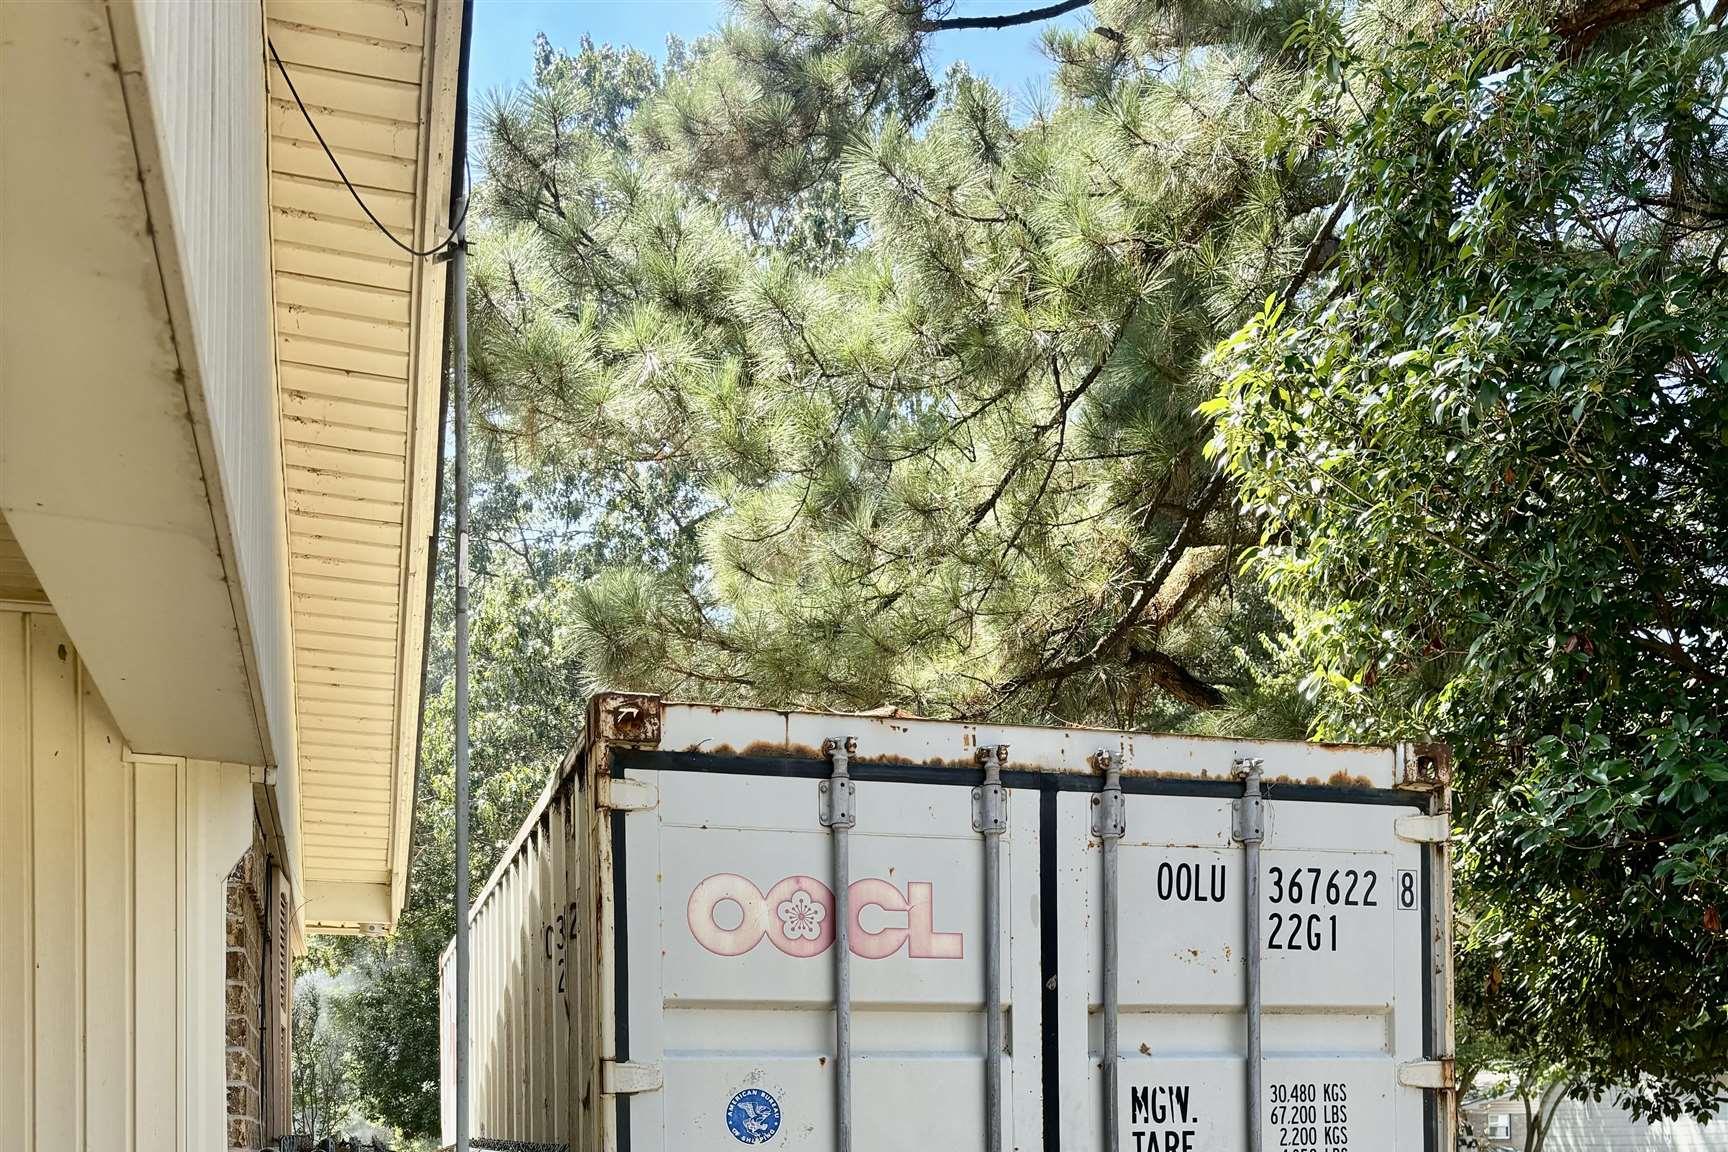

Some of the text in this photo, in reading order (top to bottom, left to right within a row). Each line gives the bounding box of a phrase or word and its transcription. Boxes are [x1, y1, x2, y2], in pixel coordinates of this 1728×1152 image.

[1268, 866, 1377, 906] 367622
[1401, 872, 1414, 907] 8
[687, 872, 963, 960] OOCL
[1268, 912, 1337, 951] 22G1
[728, 1090, 779, 1118] AMERICAN BUREAU
[1131, 1086, 1197, 1124] MGW.
[1324, 1084, 1346, 1102] KGS
[1324, 1105, 1347, 1123] LBS
[1325, 1127, 1347, 1145] KGS
